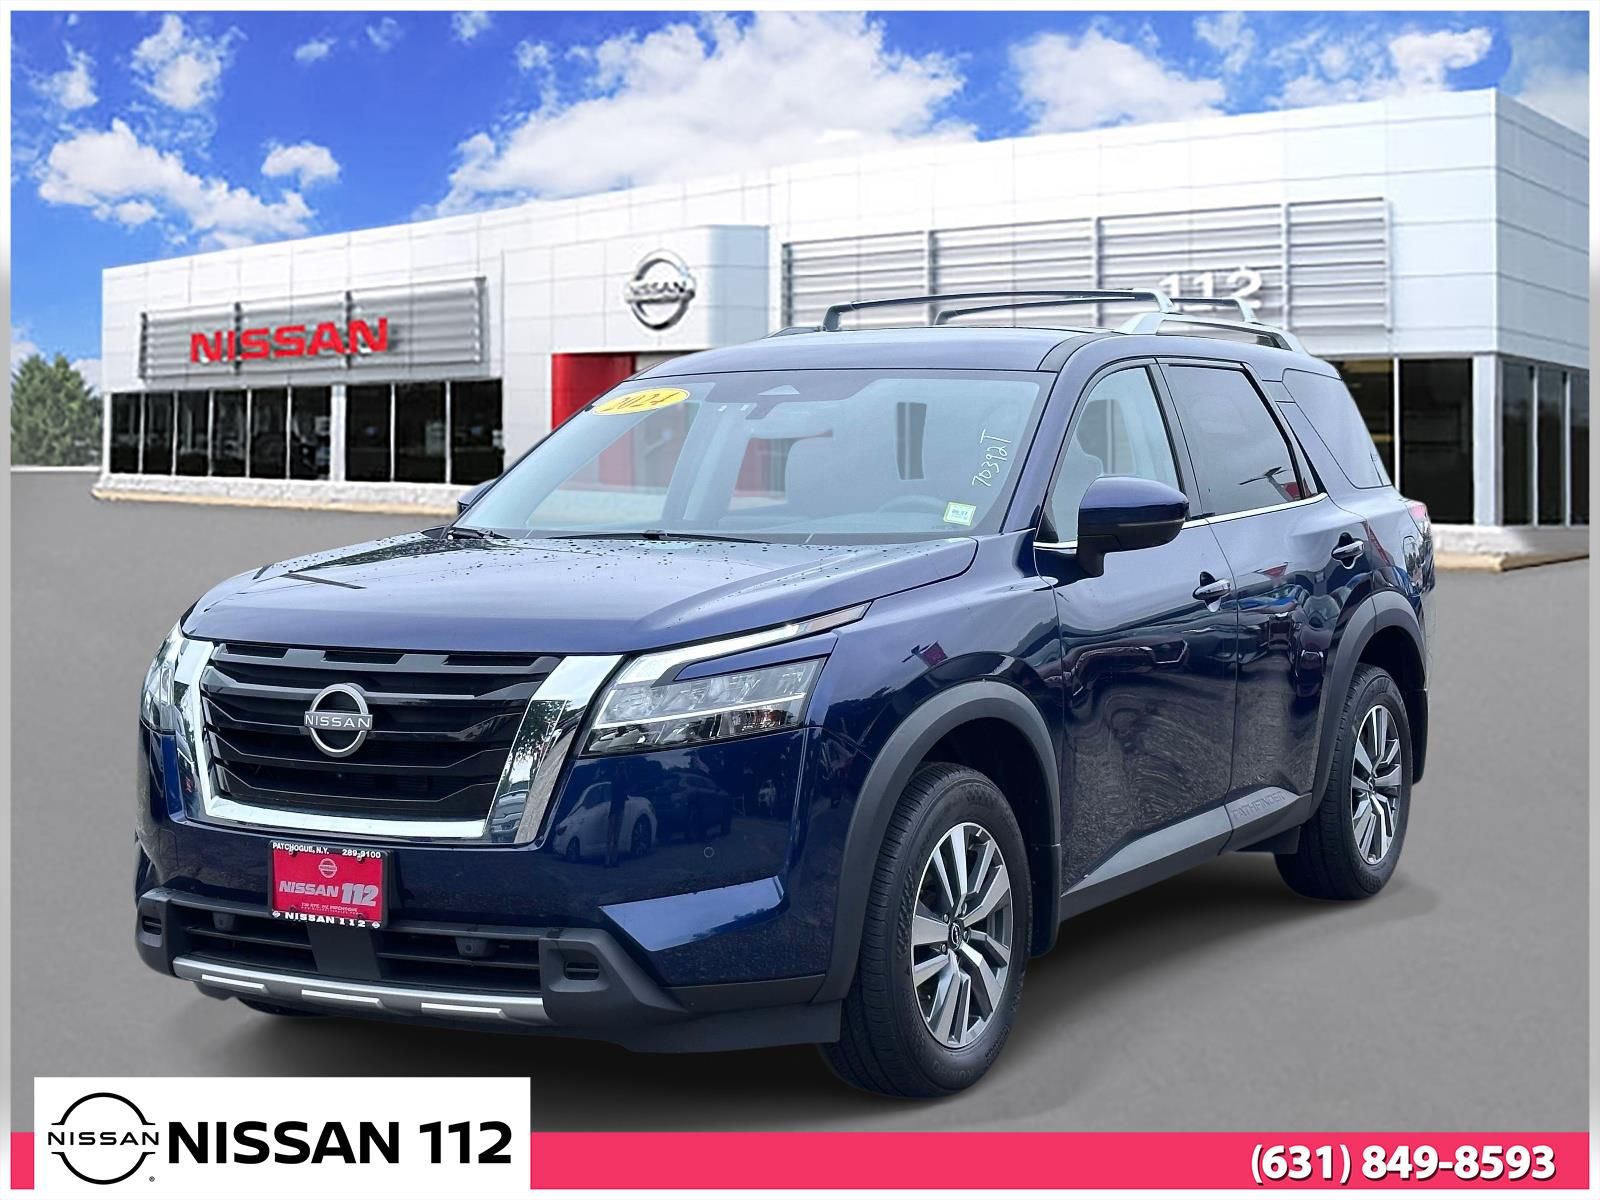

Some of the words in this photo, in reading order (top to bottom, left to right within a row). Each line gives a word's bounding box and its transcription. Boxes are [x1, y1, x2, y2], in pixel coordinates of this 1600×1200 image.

[1159, 270, 1262, 310] 112
[189, 317, 389, 364] NISSAN
[971, 428, 1012, 488] 70392T
[305, 714, 371, 729] NISSAN
[272, 842, 316, 854] PATCHOGUE,
[316, 847, 330, 855] N.Y.
[279, 880, 340, 898] NISSAN
[341, 882, 379, 907] 112
[284, 911, 335, 924] NISSAN
[339, 917, 366, 928] 112
